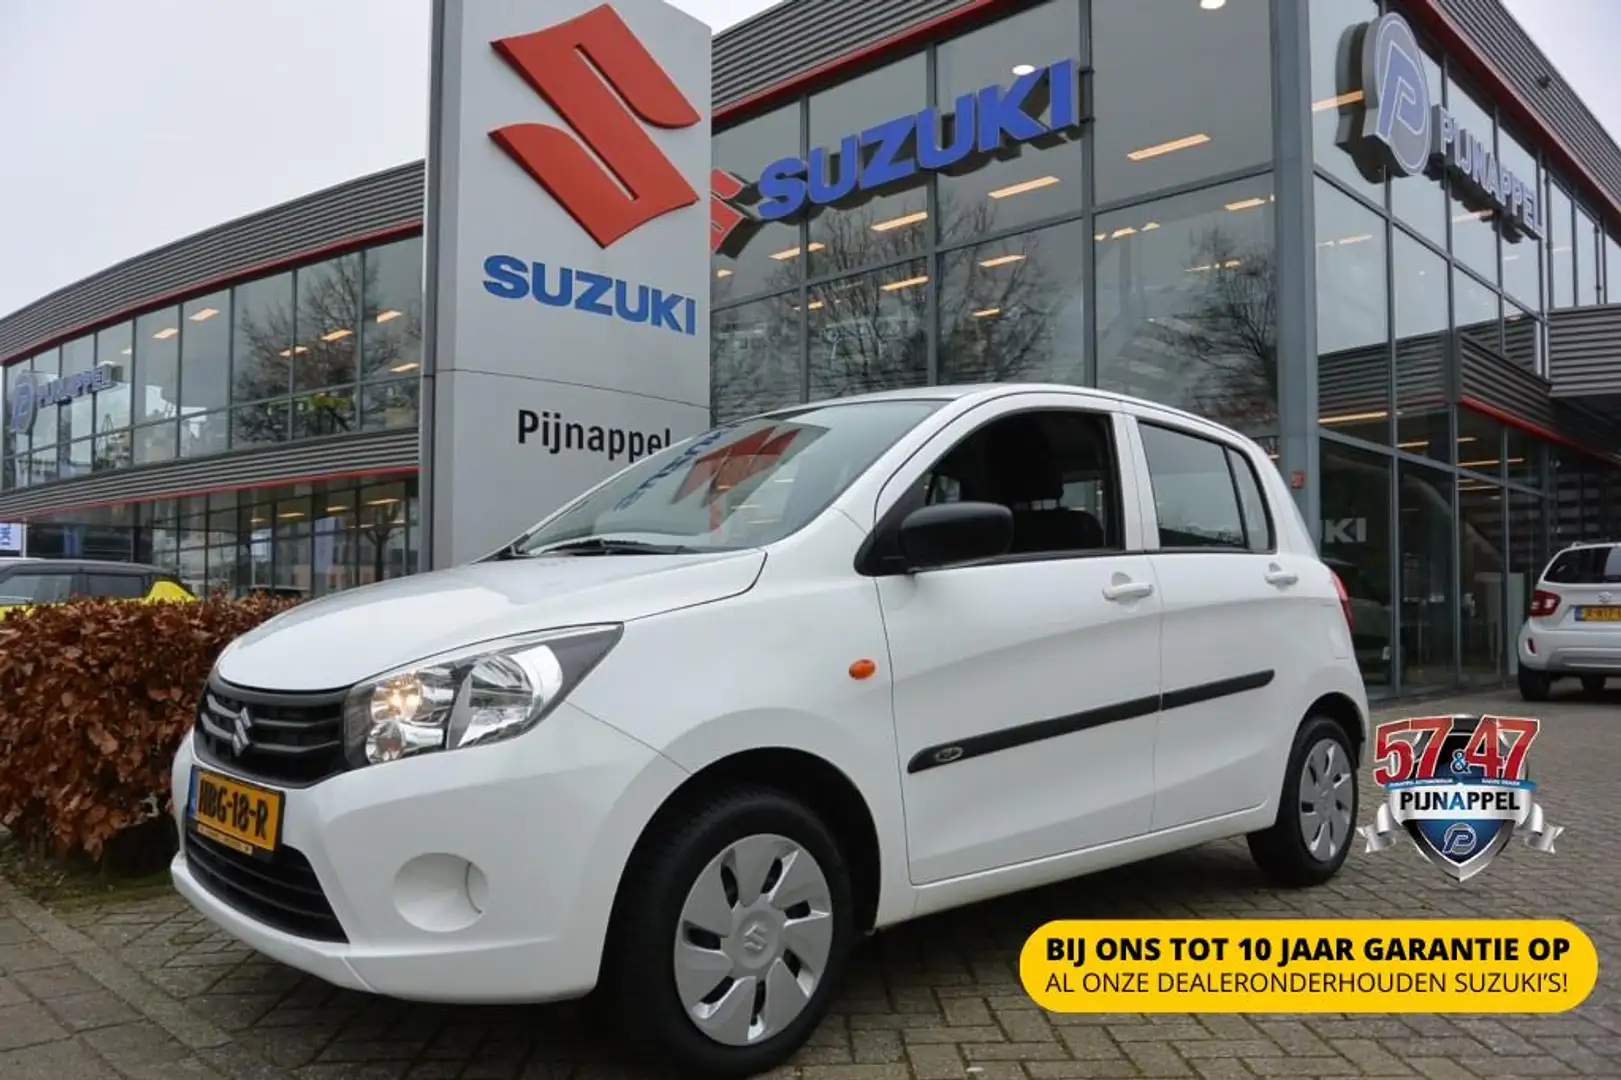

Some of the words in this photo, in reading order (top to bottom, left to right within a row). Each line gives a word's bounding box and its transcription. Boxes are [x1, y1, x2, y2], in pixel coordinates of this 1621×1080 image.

[757, 59, 1078, 222] SUZUKI
[1440, 105, 1544, 239] PIJNAPPEL
[482, 254, 696, 336] SUZUKI
[518, 409, 671, 463] Pijnappel
